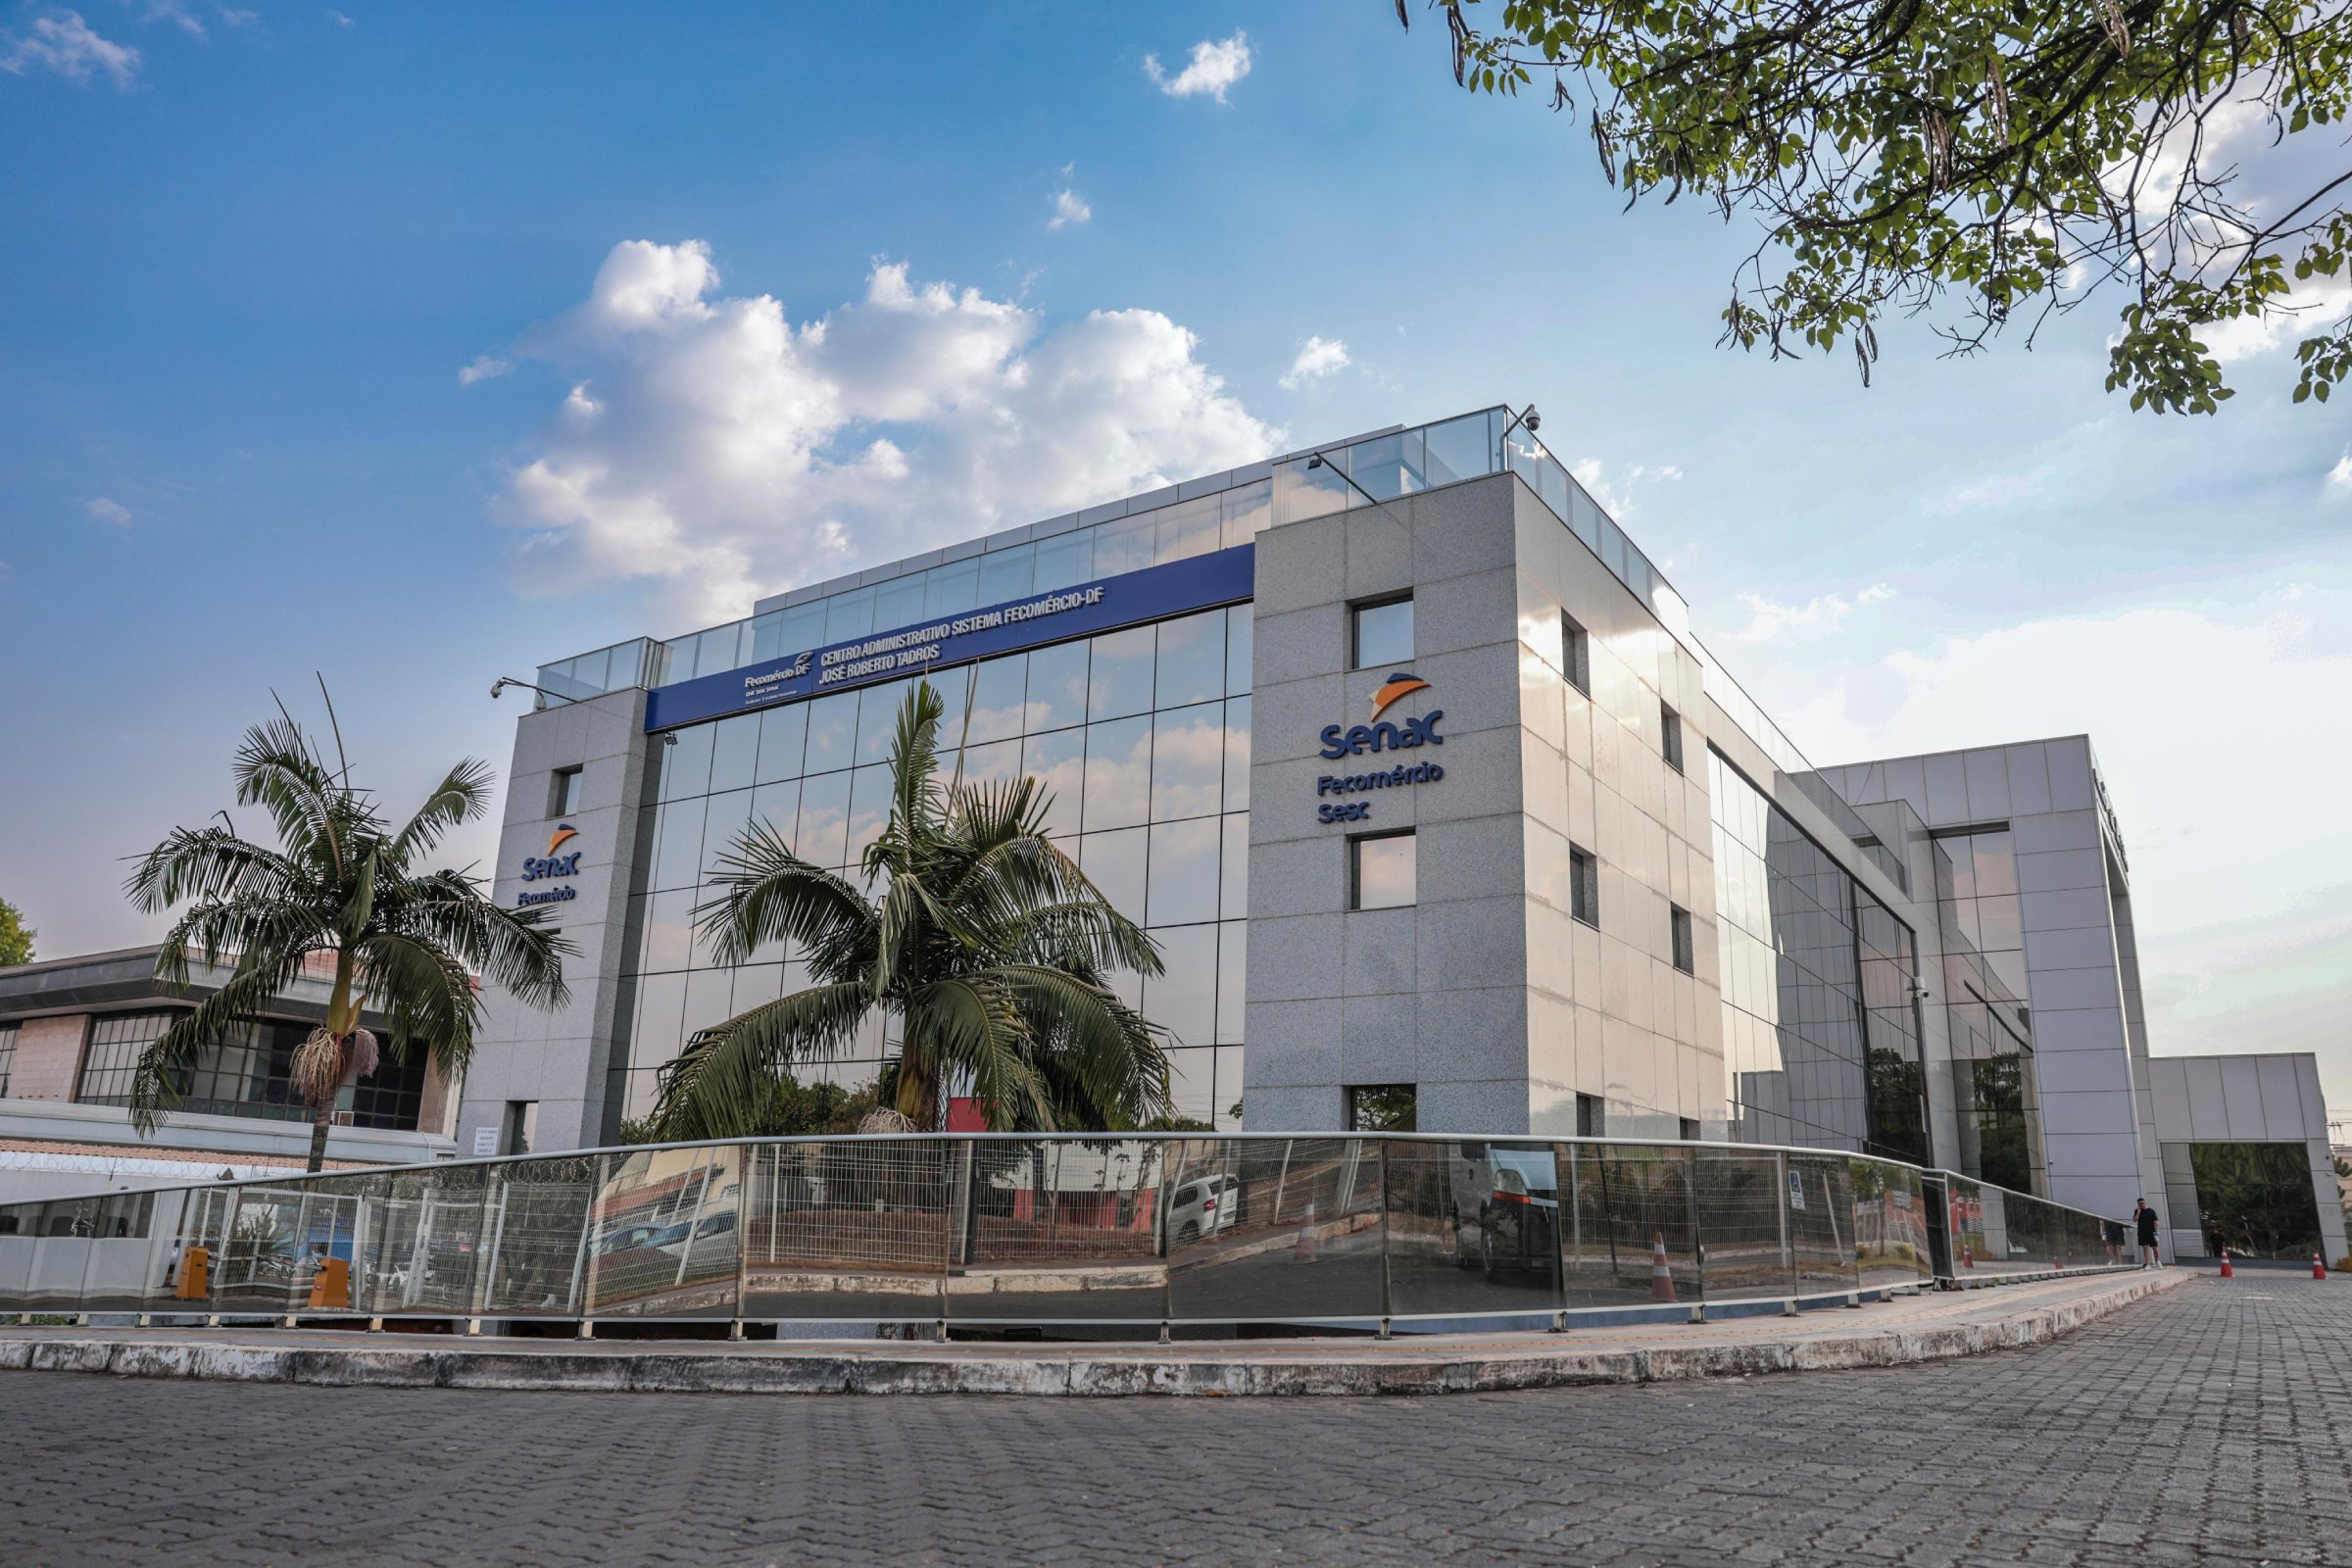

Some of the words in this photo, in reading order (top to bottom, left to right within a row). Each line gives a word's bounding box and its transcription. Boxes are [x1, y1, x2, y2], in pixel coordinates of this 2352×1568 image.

[820, 645, 862, 667] CENTRO
[861, 623, 951, 657] ADMINISTRATIVO
[952, 611, 1003, 636] SISTEMA
[1004, 586, 1104, 624] FECOMÉRCIO-DF
[745, 668, 795, 688] Fecomércio
[795, 662, 811, 675] DF
[819, 663, 847, 684] JOSÉ
[847, 654, 896, 678] ROBERTO
[897, 644, 941, 667] TADROS
[1319, 710, 1444, 760] Senac
[1317, 761, 1444, 797] Fecomércio
[1317, 801, 1370, 824] Sesc
[521, 852, 581, 882] Senac
